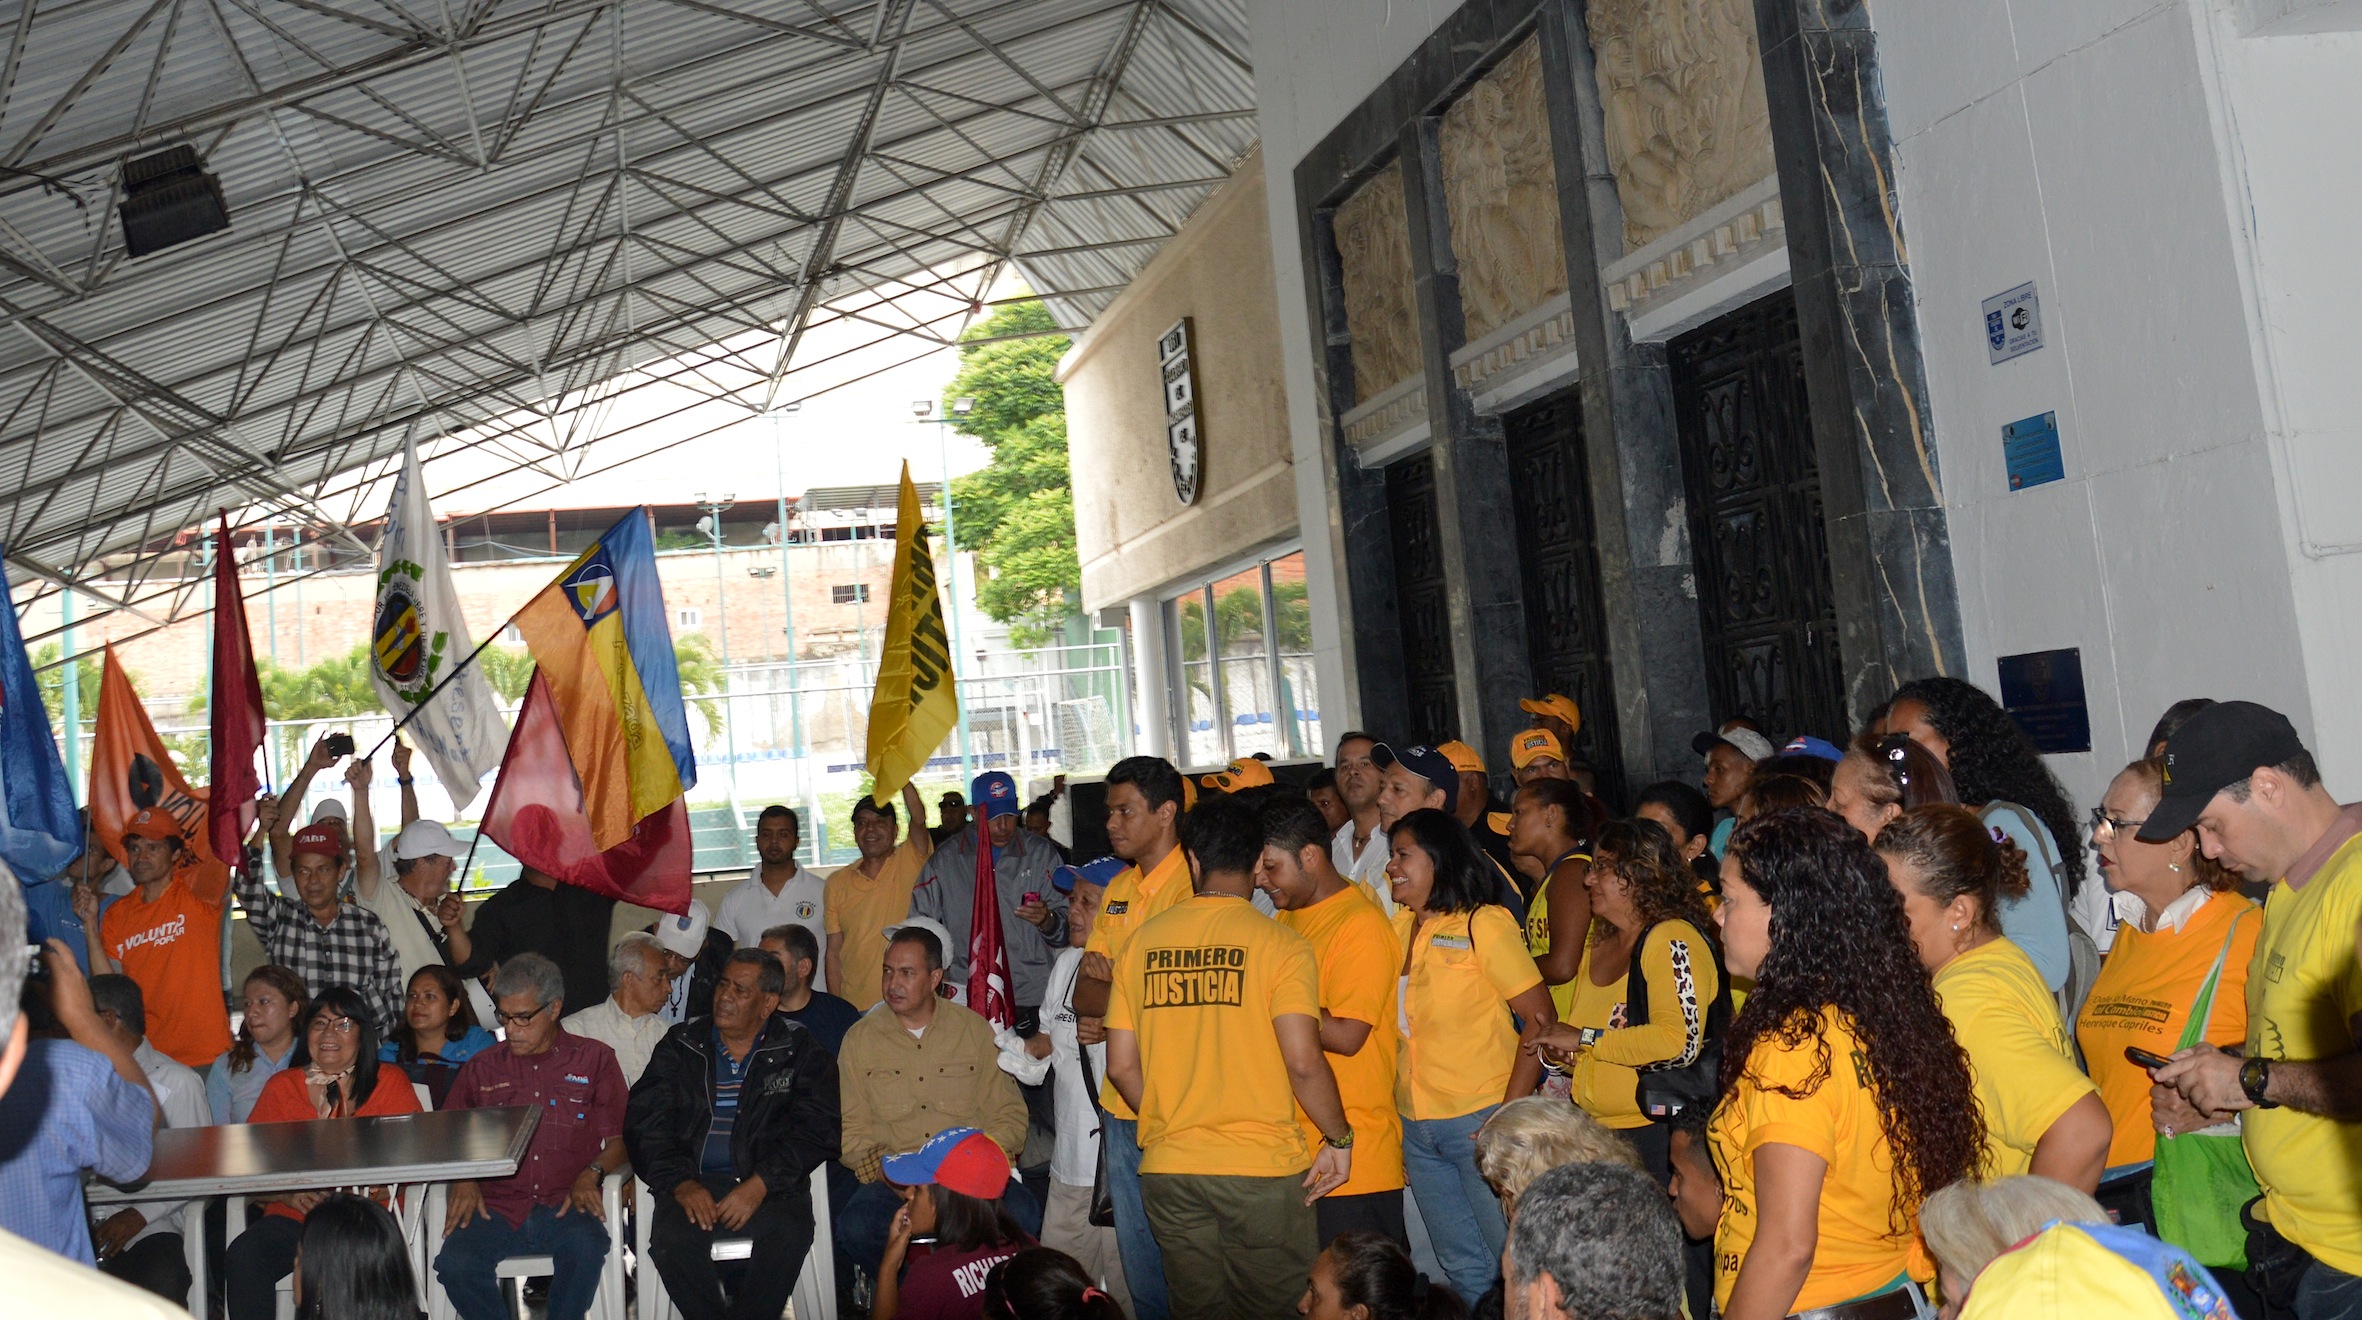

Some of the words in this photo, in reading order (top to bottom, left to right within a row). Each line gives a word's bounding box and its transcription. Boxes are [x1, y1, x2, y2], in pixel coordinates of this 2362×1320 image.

[2003, 297, 2017, 309] ZONA
[2017, 291, 2032, 303] LIBRE
[1146, 948, 1245, 970] PRIMERO
[1144, 970, 1240, 1007] JUSTICIA
[2079, 1018, 2118, 1031] Henrique
[2118, 1019, 2164, 1035] Capriles
